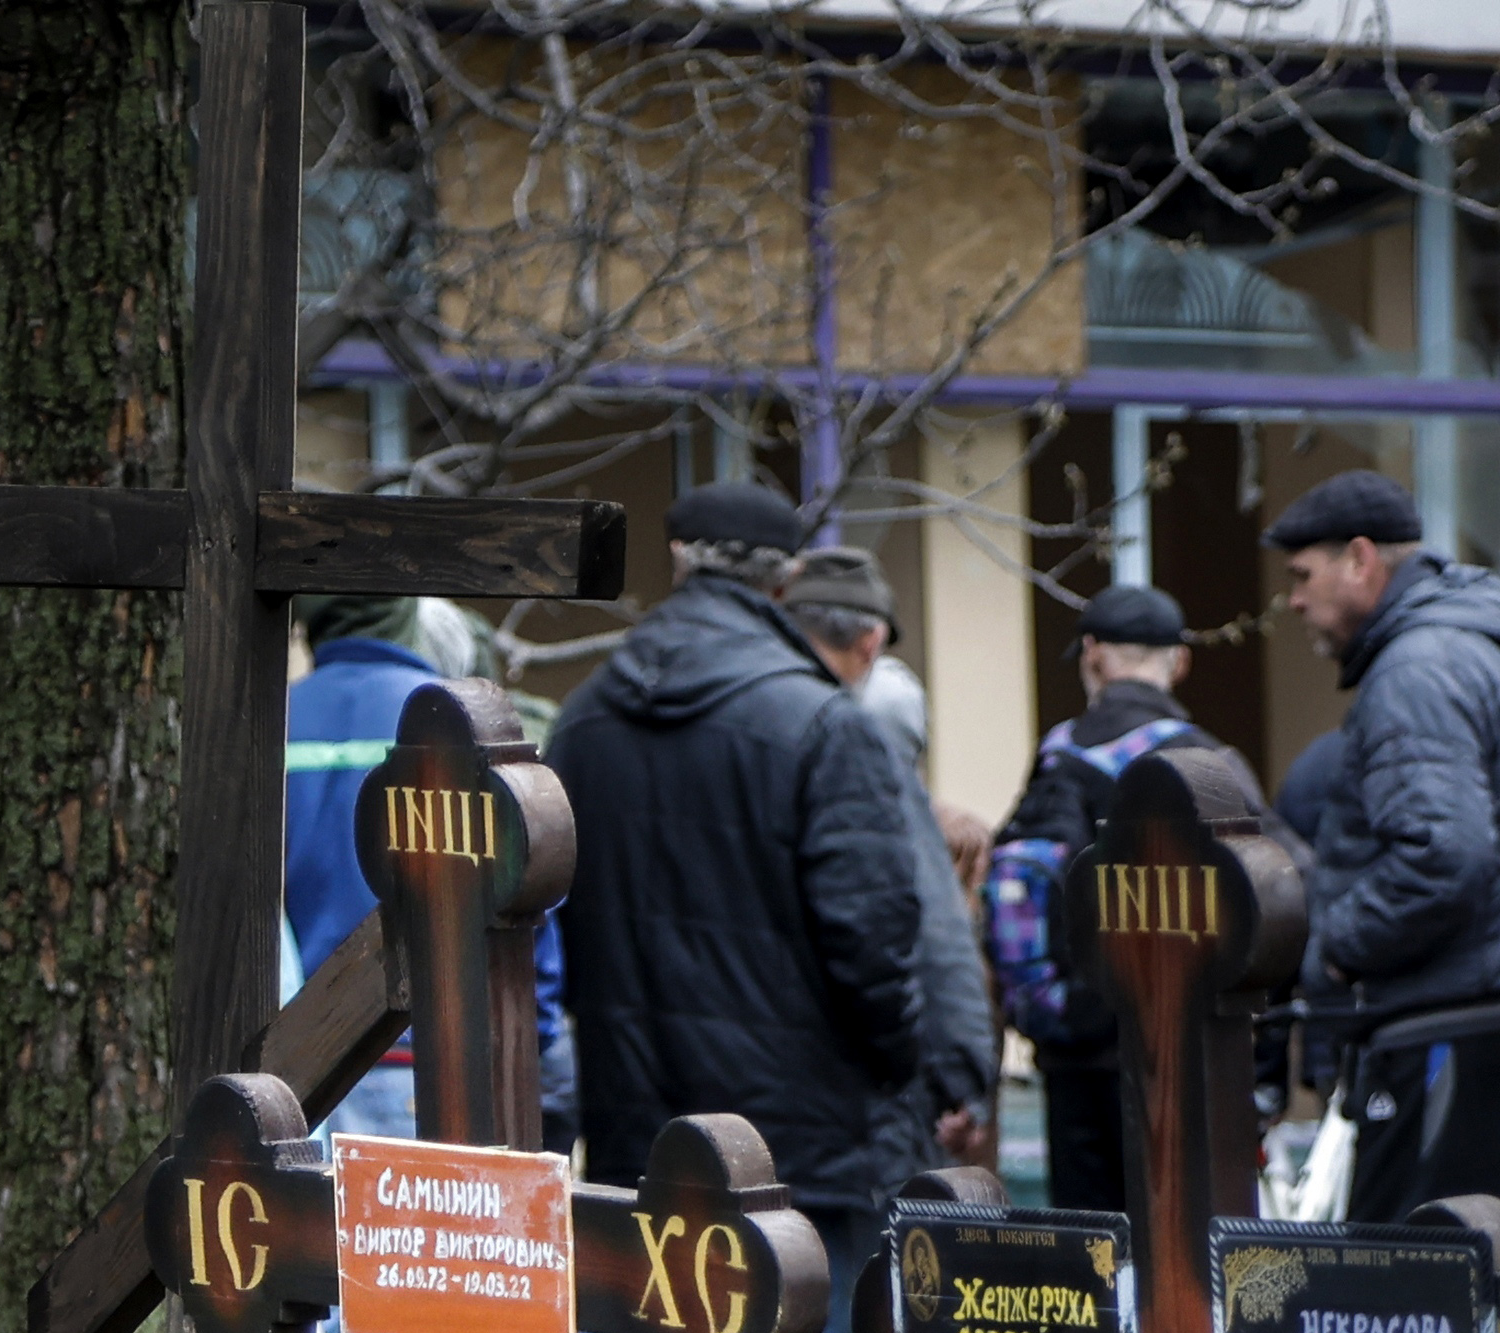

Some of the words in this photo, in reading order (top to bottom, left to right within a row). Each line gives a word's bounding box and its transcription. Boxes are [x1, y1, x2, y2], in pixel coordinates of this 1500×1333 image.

[377, 1167, 500, 1219] САМЫНИН
[354, 1223, 426, 1258] ВИКТОР
[435, 1229, 555, 1270] ВИКТОРОВИЧ
